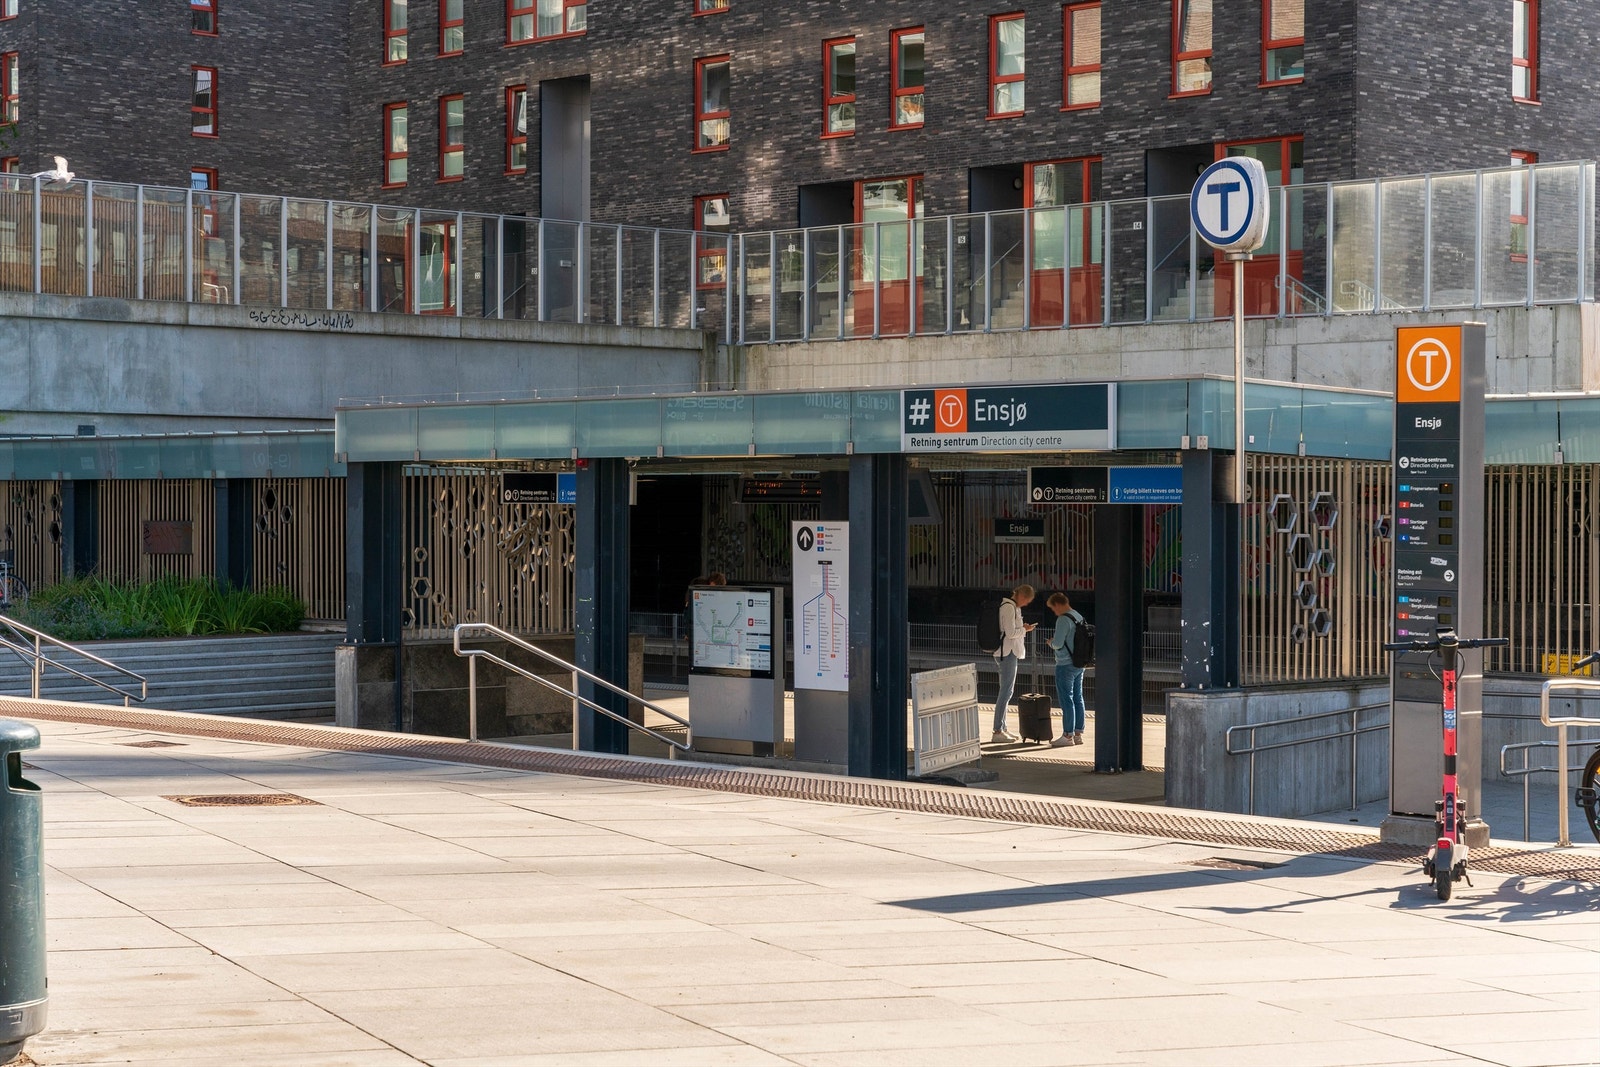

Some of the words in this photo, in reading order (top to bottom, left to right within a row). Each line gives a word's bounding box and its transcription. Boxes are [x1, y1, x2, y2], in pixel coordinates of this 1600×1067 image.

[1207, 182, 1240, 232] T
[1418, 350, 1439, 384] T
[975, 398, 1027, 426] Ensjø
[1415, 417, 1442, 430] Ensjø
[911, 437, 942, 448] Retning
[944, 438, 978, 446] sentrum
[981, 436, 1017, 446] Direction
[1019, 436, 1034, 448] city
[1036, 436, 1062, 446] centre
[1010, 524, 1030, 534] Ensjø
